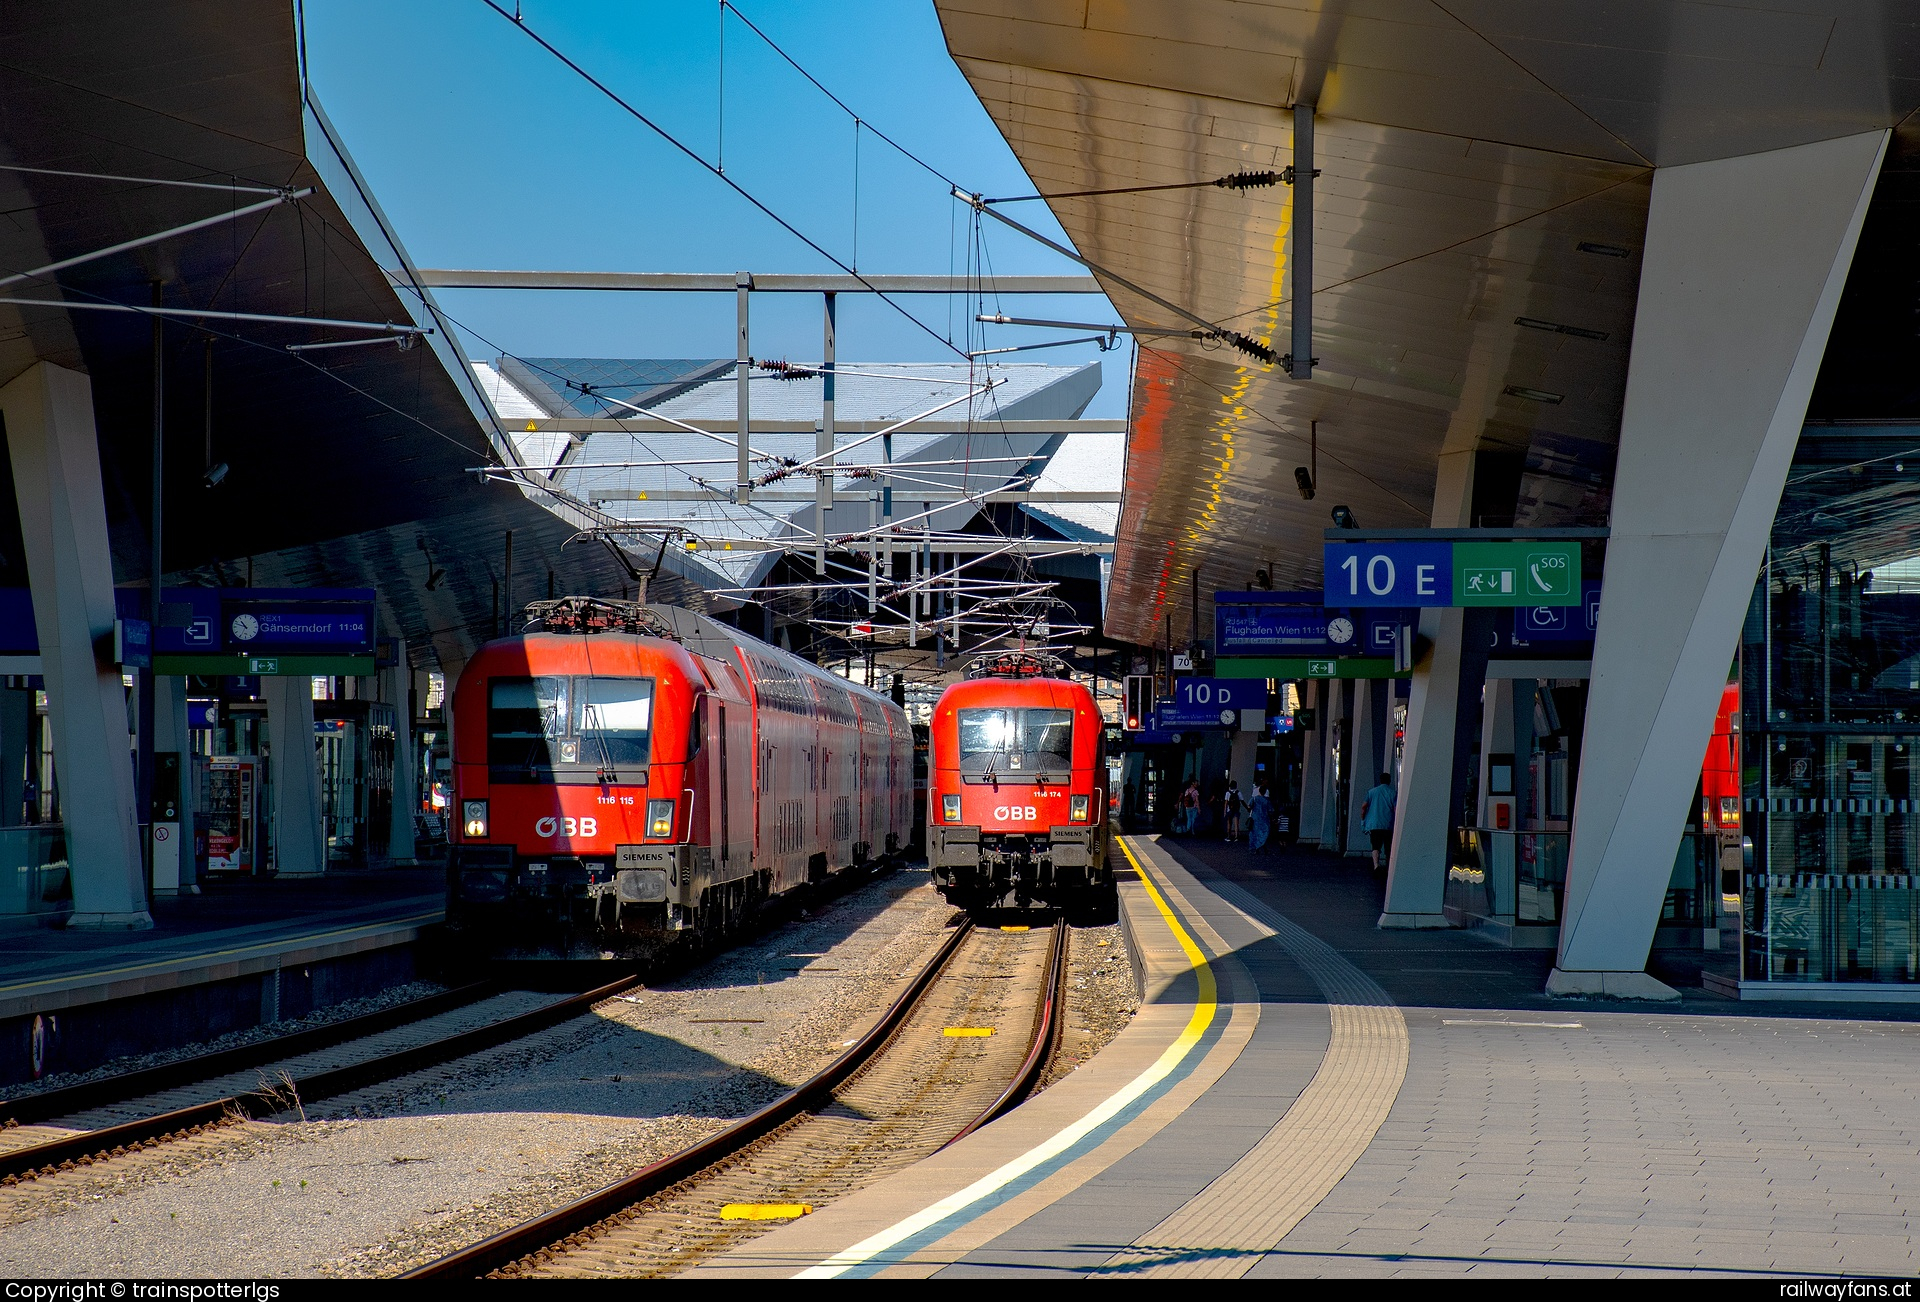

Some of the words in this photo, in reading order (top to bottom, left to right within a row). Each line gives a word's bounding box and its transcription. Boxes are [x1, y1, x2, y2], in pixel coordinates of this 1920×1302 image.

[1541, 557, 1566, 569] SOS
[1341, 555, 1396, 596] 10
[1416, 565, 1435, 595] E
[259, 622, 332, 633] Gänserndorf
[339, 623, 364, 631] 11:04
[1225, 626, 1273, 637] Flughafen
[1275, 626, 1301, 635] Wien
[1302, 626, 1327, 634] 11:12
[1178, 658, 1189, 667] 70
[1184, 683, 1211, 704] 10
[1218, 688, 1231, 704] D
[596, 796, 616, 804] 1116
[619, 796, 634, 805] 115
[993, 806, 1037, 821] ÖBB
[535, 816, 597, 837] ÖBB
[623, 853, 663, 861] SIEMENS
